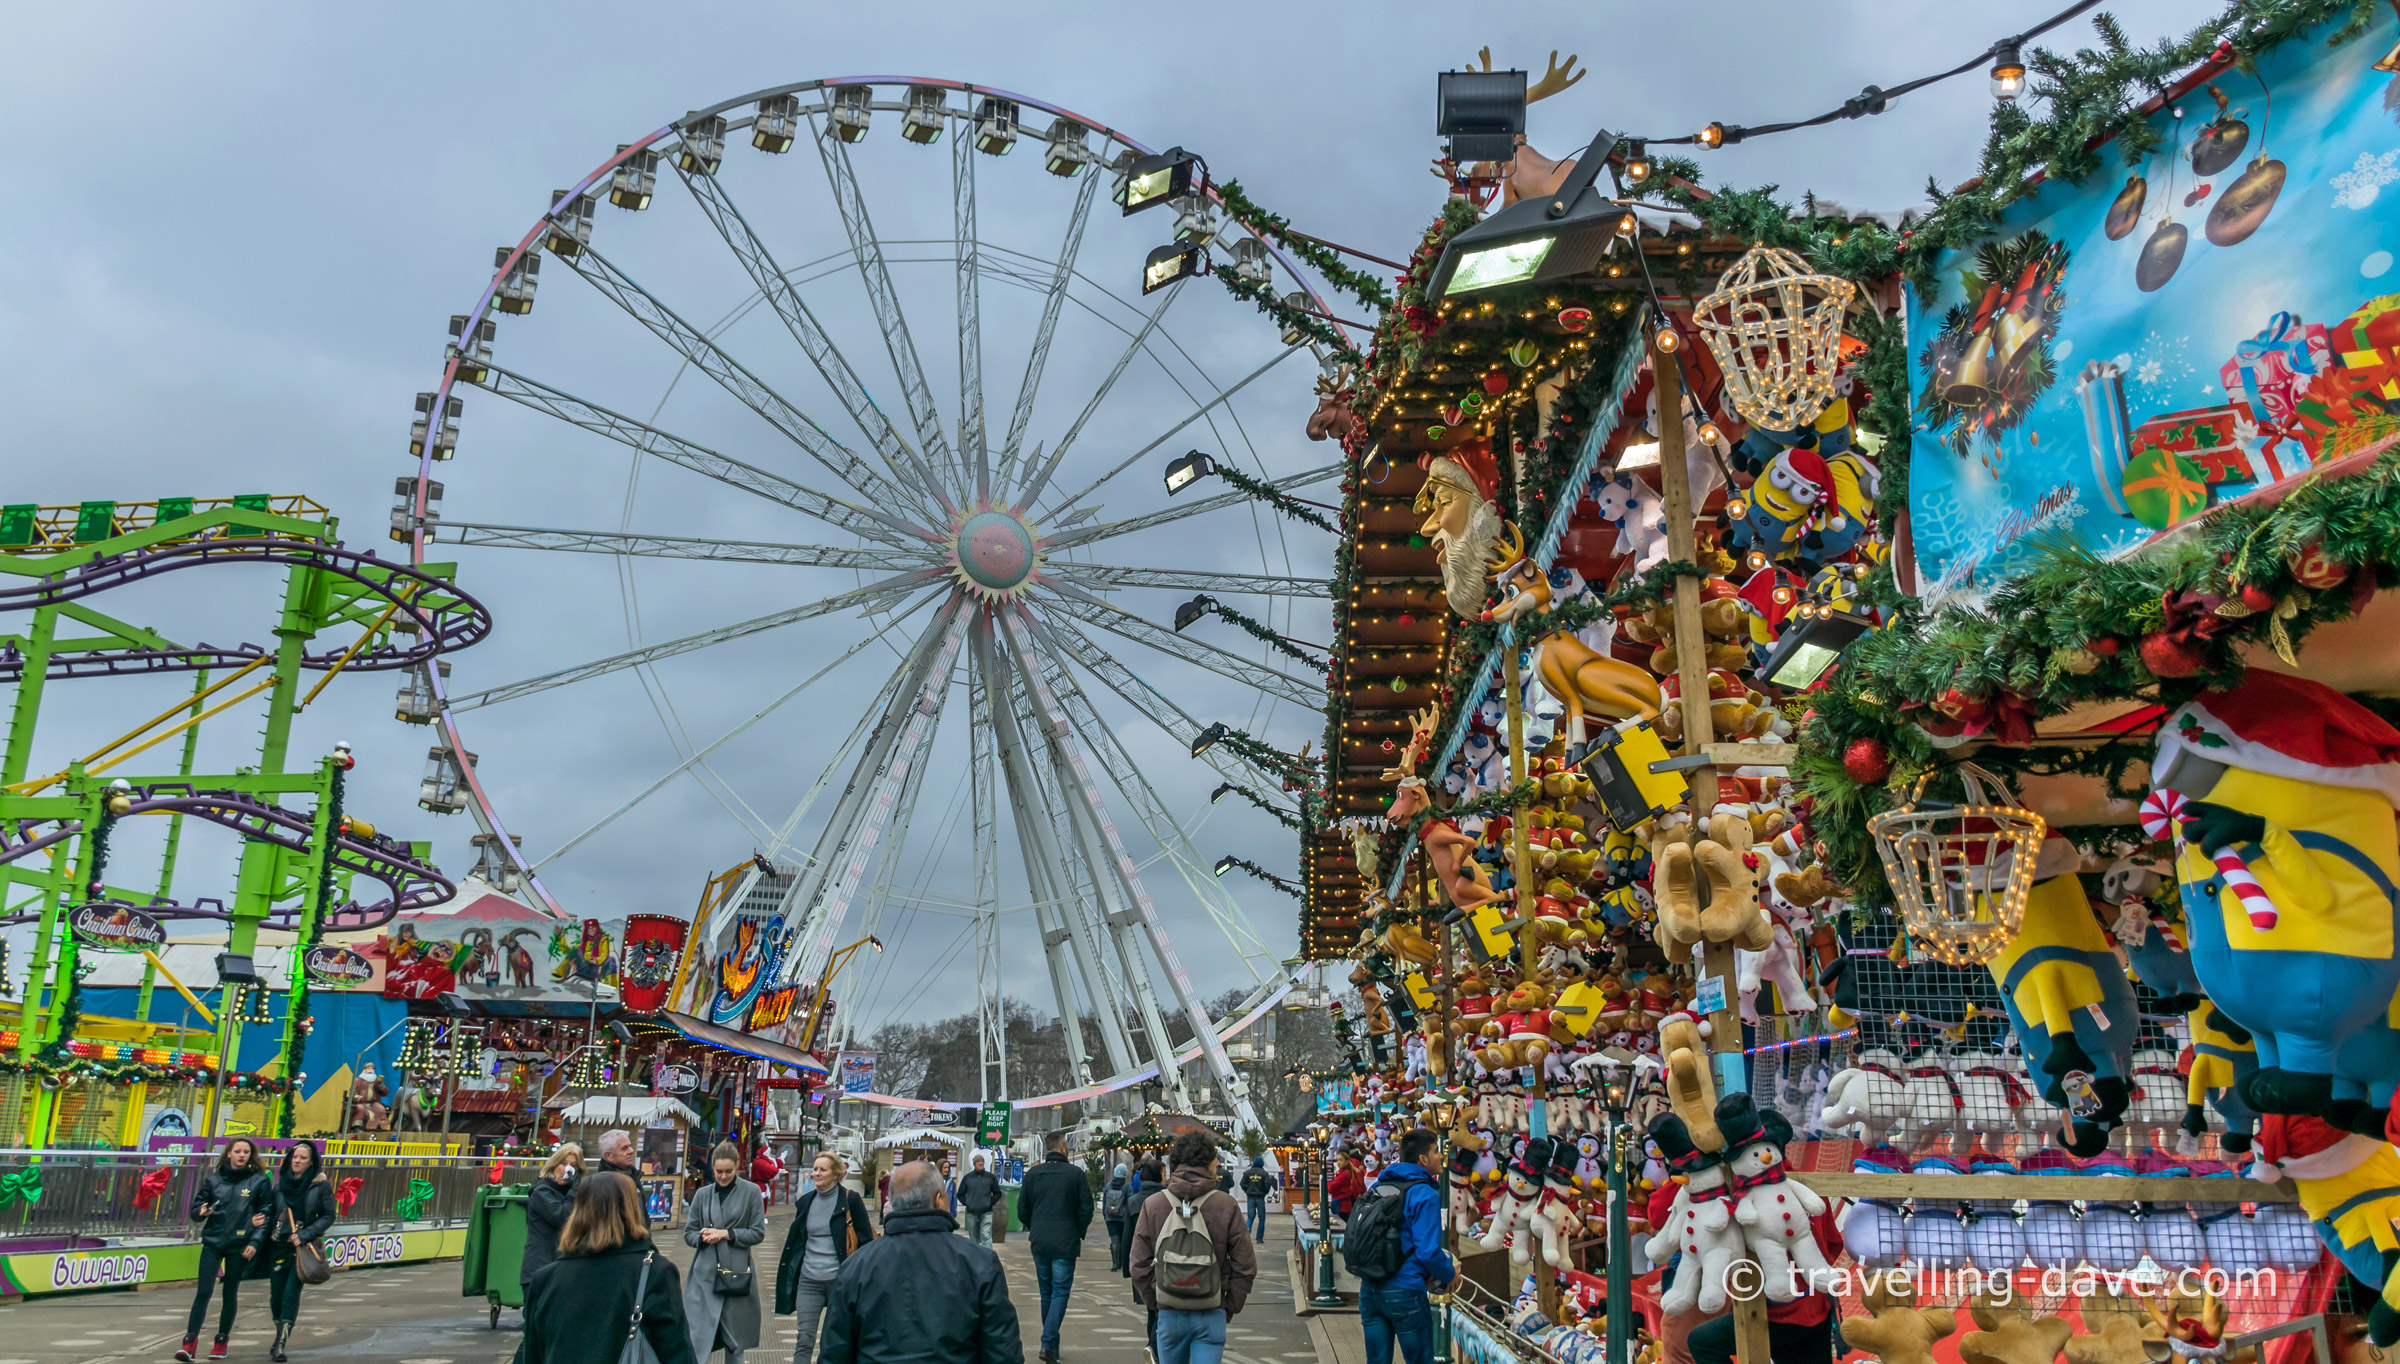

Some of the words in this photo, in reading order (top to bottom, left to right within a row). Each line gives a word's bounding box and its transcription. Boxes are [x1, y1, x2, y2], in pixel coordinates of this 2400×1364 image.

[1927, 549, 1981, 608] Merry
[1996, 479, 2075, 553] Christmas
[77, 908, 126, 937] Christmas
[126, 916, 160, 942] Coaster
[311, 951, 345, 973] Christmas
[345, 956, 370, 978] Coaster
[930, 1112, 953, 1121] TOKENS
[324, 1235, 404, 1265] COASTERS
[53, 1255, 148, 1287] BUWALDA
